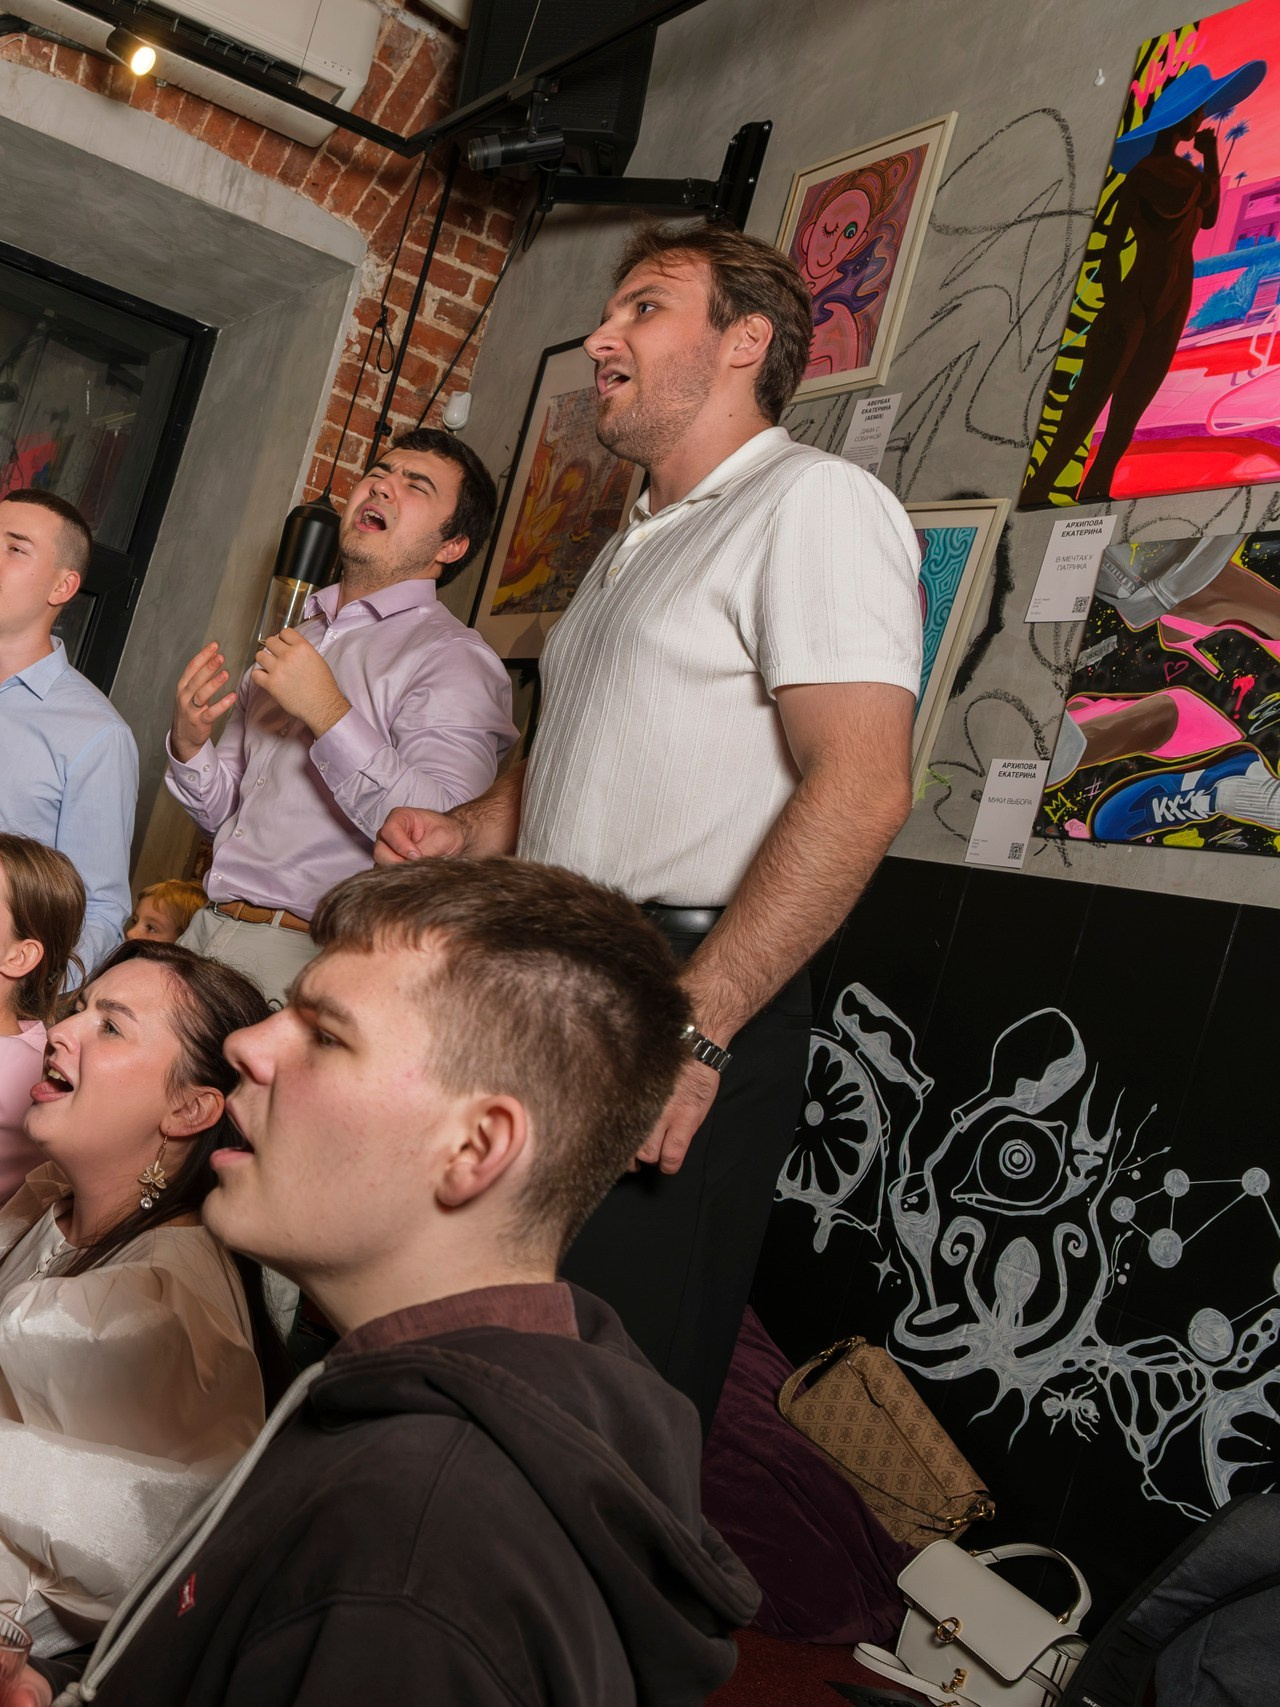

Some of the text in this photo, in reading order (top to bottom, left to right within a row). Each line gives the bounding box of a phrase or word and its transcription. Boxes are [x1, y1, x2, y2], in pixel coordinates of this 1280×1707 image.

[861, 405, 891, 415] ЕКАТЕРИНА
[1065, 519, 1104, 529] АРХИПОВА
[1061, 528, 1103, 538] ЕКАТЕРИНА
[1062, 554, 1089, 563] МЕЧТАХ
[1056, 563, 1088, 571] ПАТРИКА
[1001, 762, 1038, 770] АРХИПОВА
[998, 771, 1037, 779] ЕКАТЕРИНА
[987, 796, 1033, 806] МУКИ ВЫБОРА
